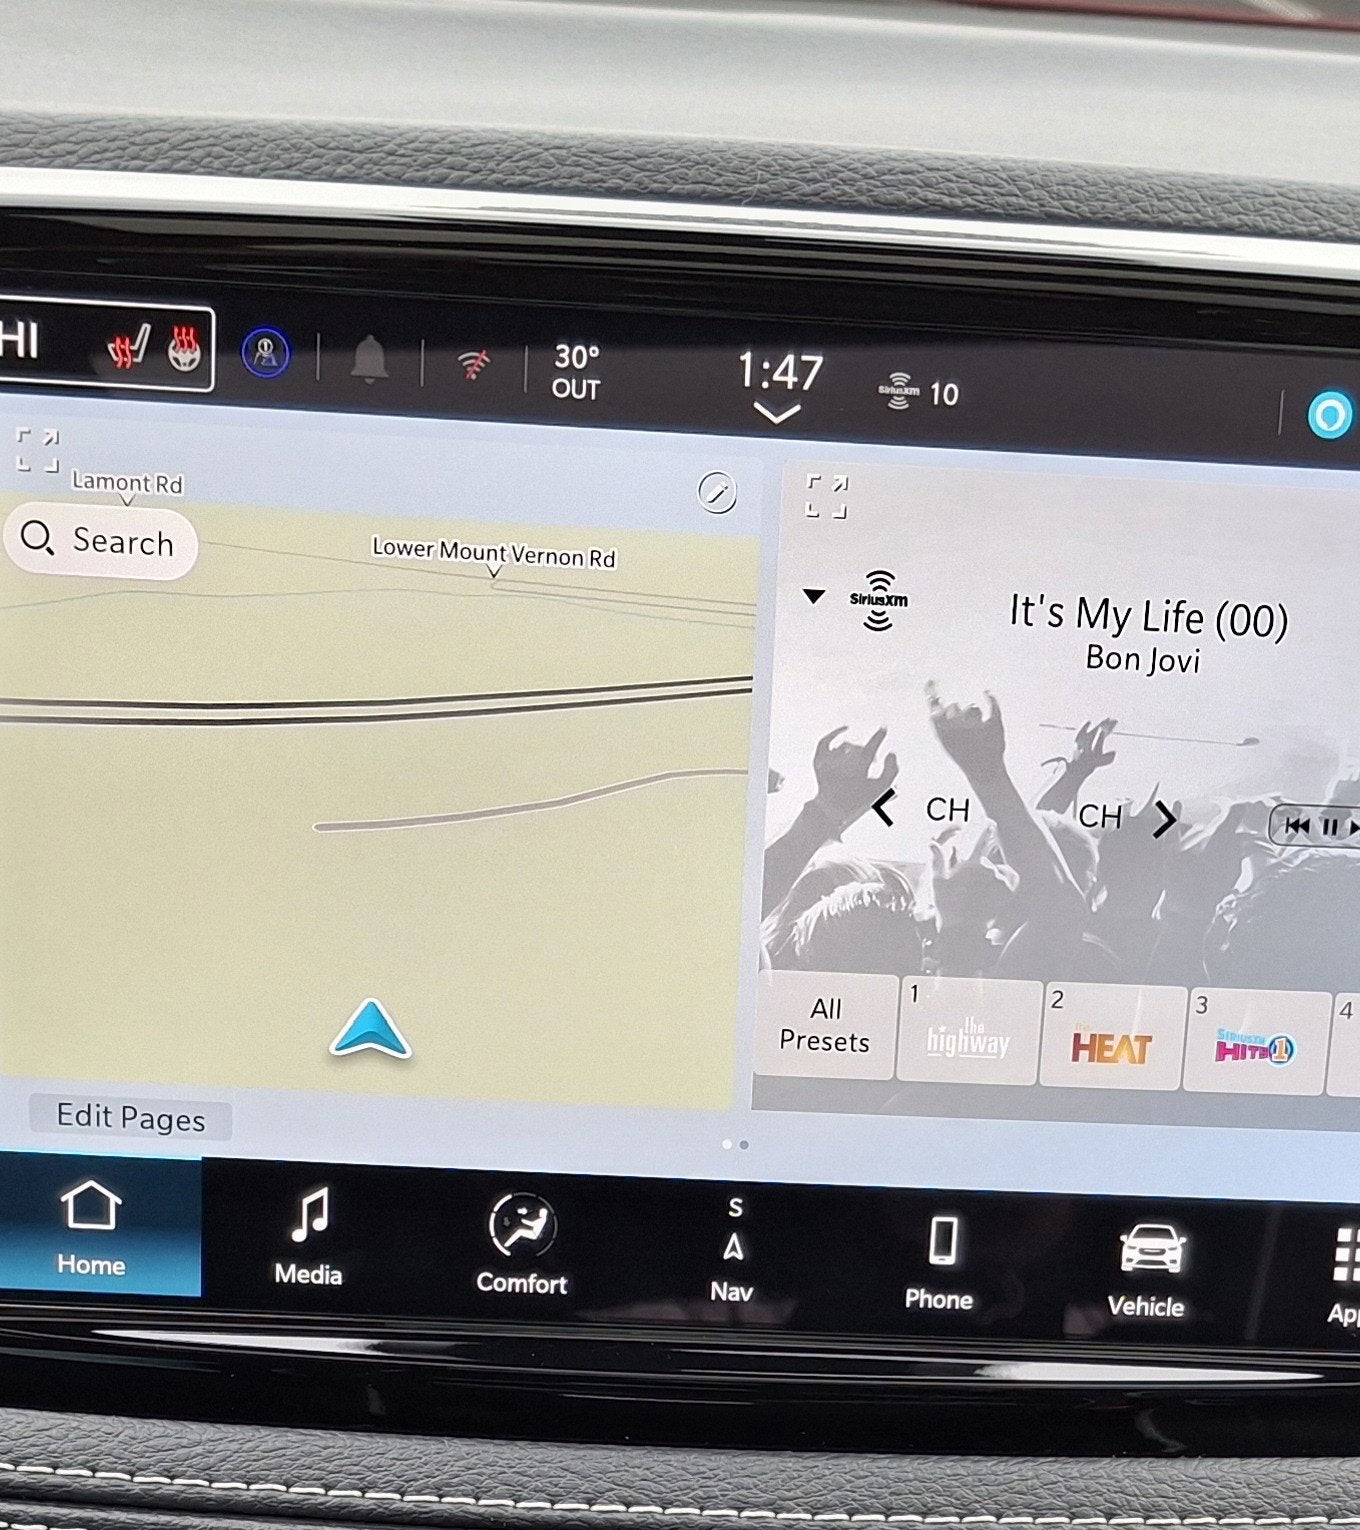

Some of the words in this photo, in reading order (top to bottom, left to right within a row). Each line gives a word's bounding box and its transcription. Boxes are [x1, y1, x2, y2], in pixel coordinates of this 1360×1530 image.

[554, 343, 600, 369] 30°
[739, 351, 824, 391] 1:47
[552, 377, 602, 400] OUT
[931, 381, 959, 406] 10
[72, 470, 152, 496] Lamont
[157, 474, 183, 496] Rd
[73, 526, 173, 557] Search
[371, 534, 434, 561] Lower
[439, 540, 507, 564] Mount
[512, 543, 586, 567] Vernon
[592, 547, 617, 570] Rd
[1011, 593, 1064, 628] It's
[1077, 596, 1132, 639] My
[1143, 598, 1204, 635] Life
[1216, 600, 1288, 645] (00)
[1086, 643, 1140, 671] Bon
[1146, 646, 1201, 677] Jovi
[924, 794, 972, 825] CH
[1078, 802, 1123, 831] CH
[910, 984, 922, 1004] 1
[1051, 990, 1064, 1009] 2
[1195, 995, 1208, 1015] 3
[809, 997, 841, 1020] All
[1339, 1001, 1354, 1020] 4
[964, 1017, 986, 1035] the
[780, 1028, 870, 1053] Presets
[926, 1025, 1012, 1060] highway
[1071, 1033, 1153, 1065] HEAT
[58, 1102, 113, 1128] Edit
[122, 1105, 205, 1136] Pages
[728, 1197, 743, 1218] S
[56, 1253, 128, 1278] Home
[275, 1262, 343, 1286] Media
[476, 1271, 569, 1295] Comfort
[710, 1281, 754, 1302] Nav
[905, 1287, 974, 1310] Phone
[1107, 1295, 1185, 1318] Vehicle
